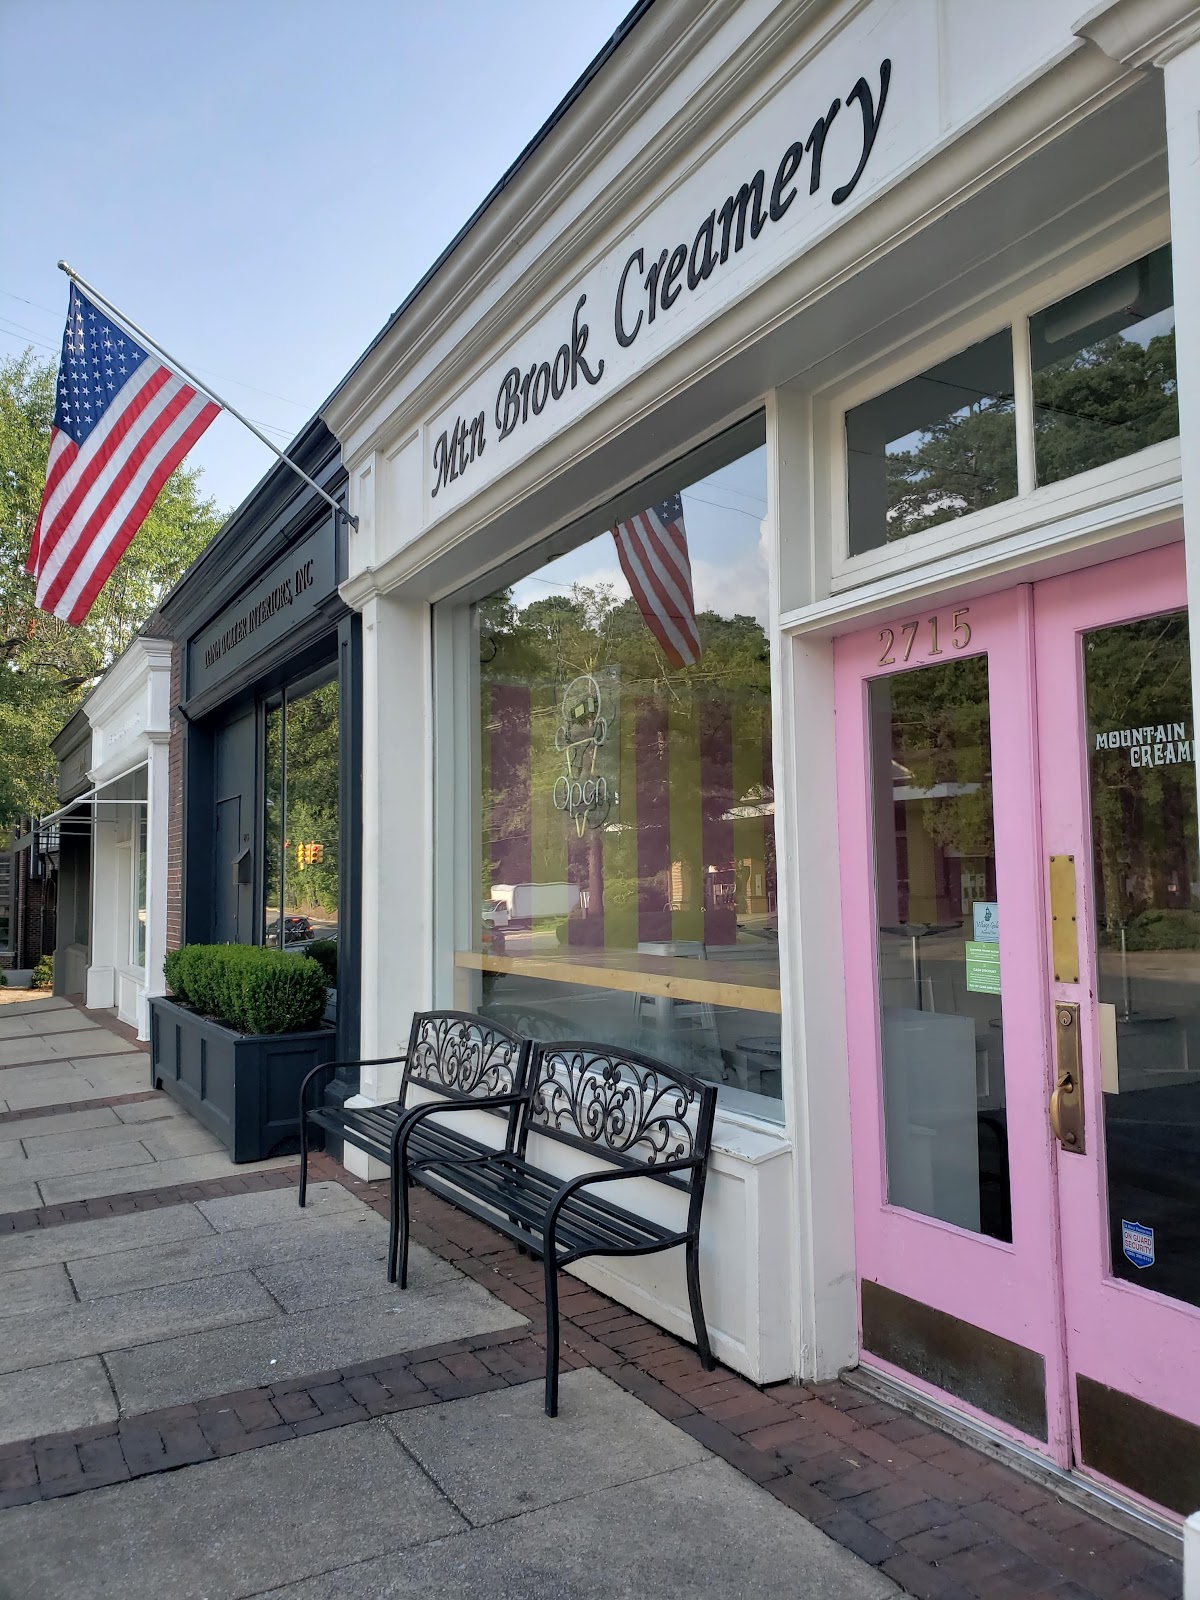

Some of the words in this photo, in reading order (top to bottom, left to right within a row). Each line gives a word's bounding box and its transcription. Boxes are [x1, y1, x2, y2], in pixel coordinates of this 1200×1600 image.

[431, 410, 487, 498] Mtn
[495, 293, 605, 443] Brook
[614, 58, 892, 349] Creamery
[294, 559, 314, 597] INC
[878, 607, 972, 667] 2715
[1095, 722, 1186, 750] MOUNTAIN
[1130, 739, 1196, 768] CREAM
[553, 776, 608, 818] Open
[1124, 1231, 1132, 1239] ON
[1133, 1234, 1152, 1246] GUARD
[1124, 1239, 1152, 1254] SECURITY
